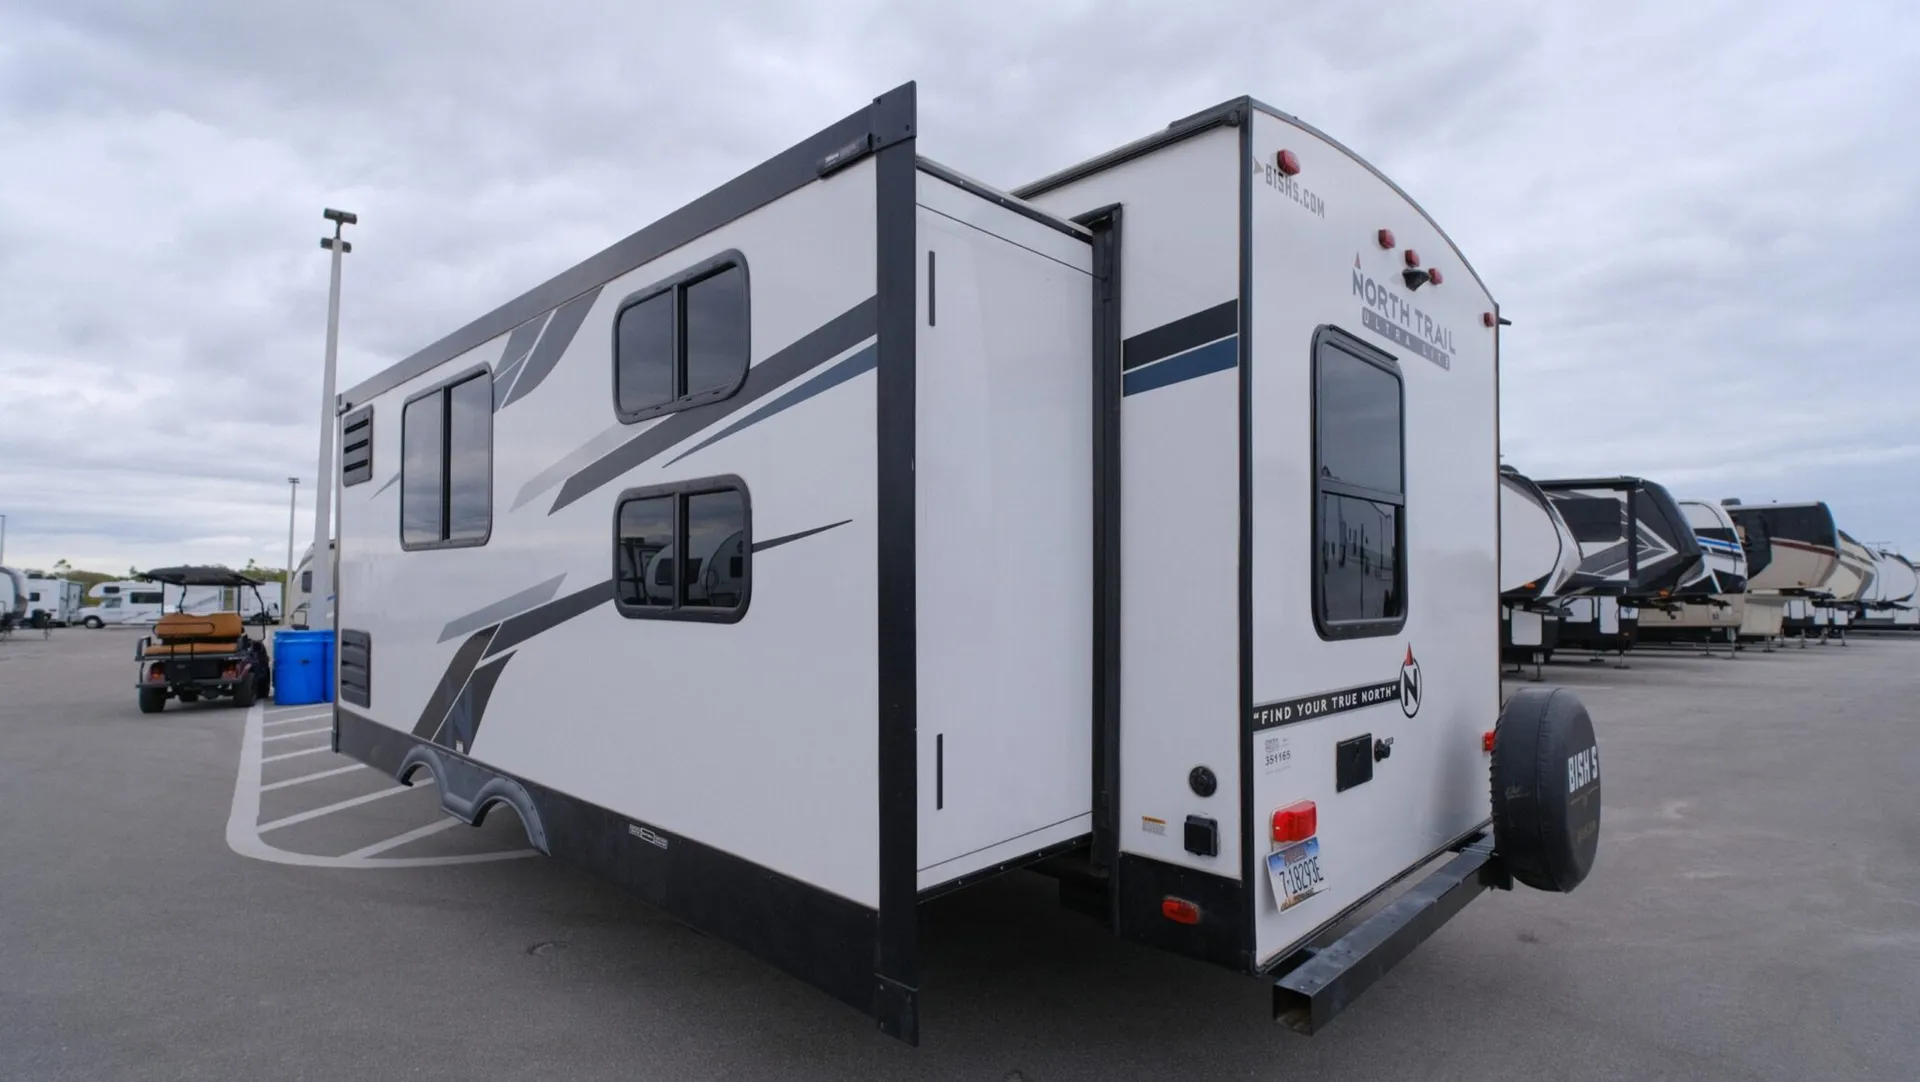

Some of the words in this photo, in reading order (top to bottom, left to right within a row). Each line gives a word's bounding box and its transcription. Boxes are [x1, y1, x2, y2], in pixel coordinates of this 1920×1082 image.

[1265, 164, 1325, 218] BISHS.COM
[1353, 269, 1410, 327] NORTH
[1414, 308, 1456, 354] TRAIL
[1363, 311, 1411, 348] ULTRA
[1422, 343, 1450, 369] LITE
[1297, 700, 1328, 716] YOUR
[1332, 693, 1358, 708] TRUE
[1403, 668, 1418, 706] N
[1264, 750, 1291, 766] 351165
[1279, 856, 1324, 898] 7-18293E
